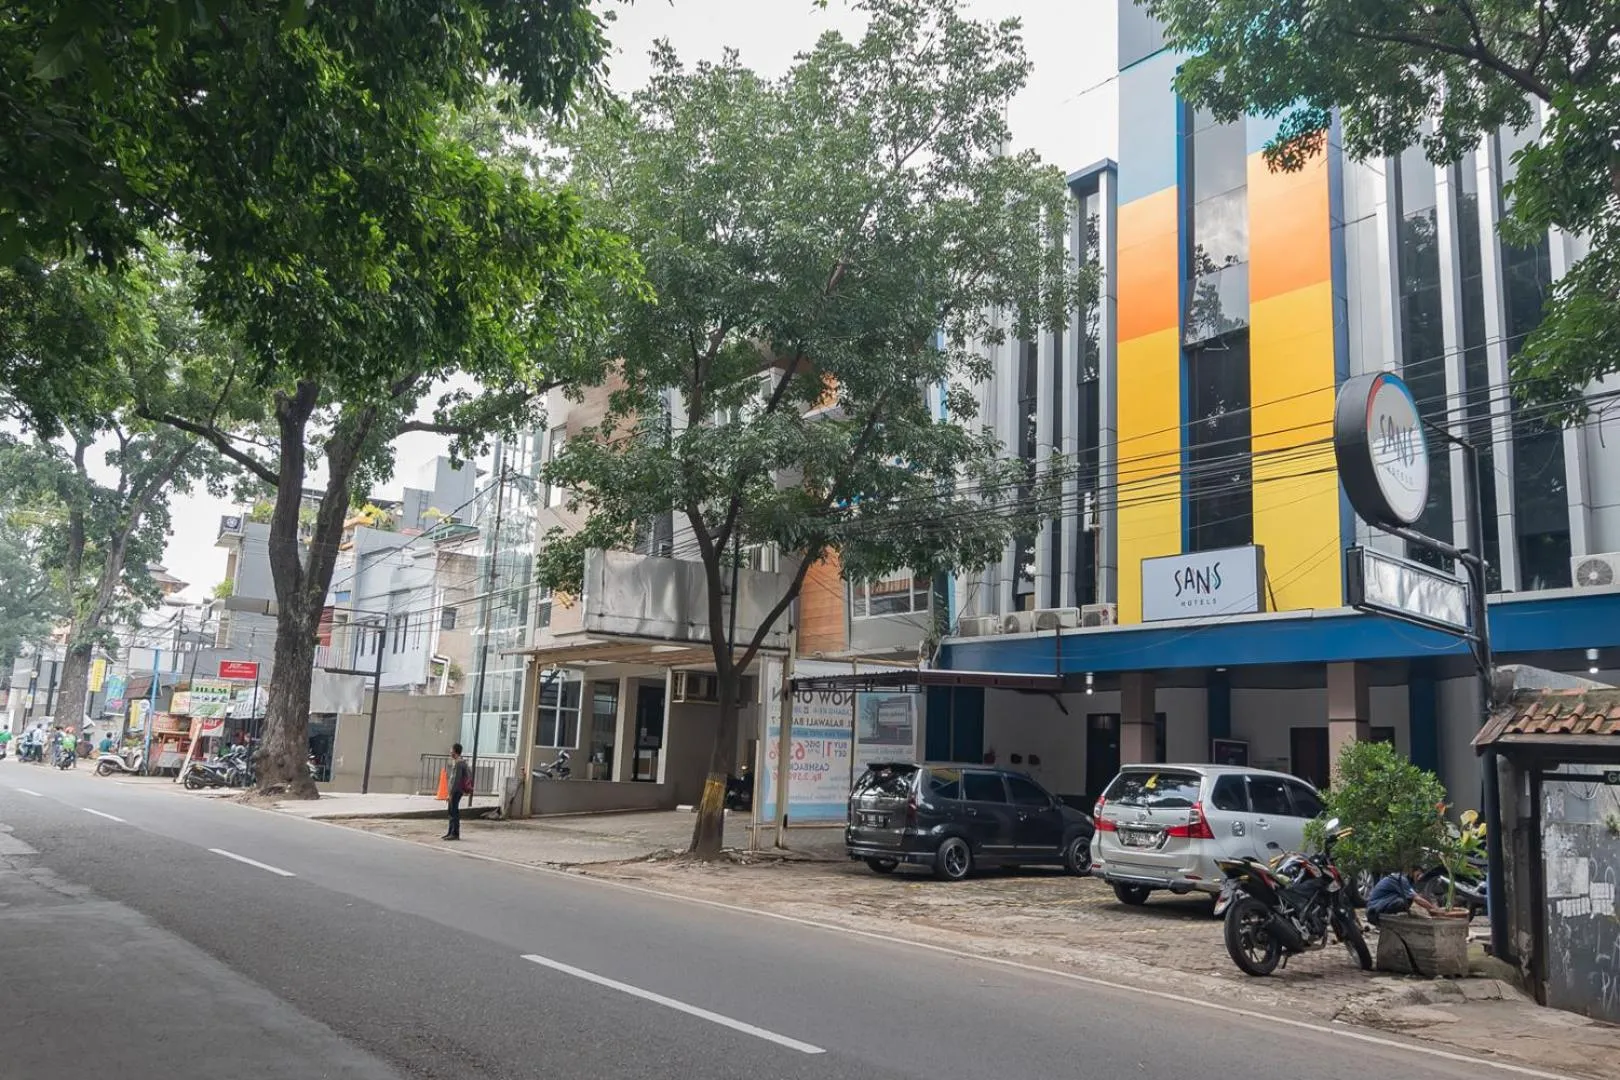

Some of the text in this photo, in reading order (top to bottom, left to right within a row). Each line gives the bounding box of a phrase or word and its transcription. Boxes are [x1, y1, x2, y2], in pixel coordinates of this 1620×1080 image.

[1380, 414, 1415, 468] SANS
[1174, 561, 1222, 597] SANS
[1180, 598, 1217, 607] HOTELS
